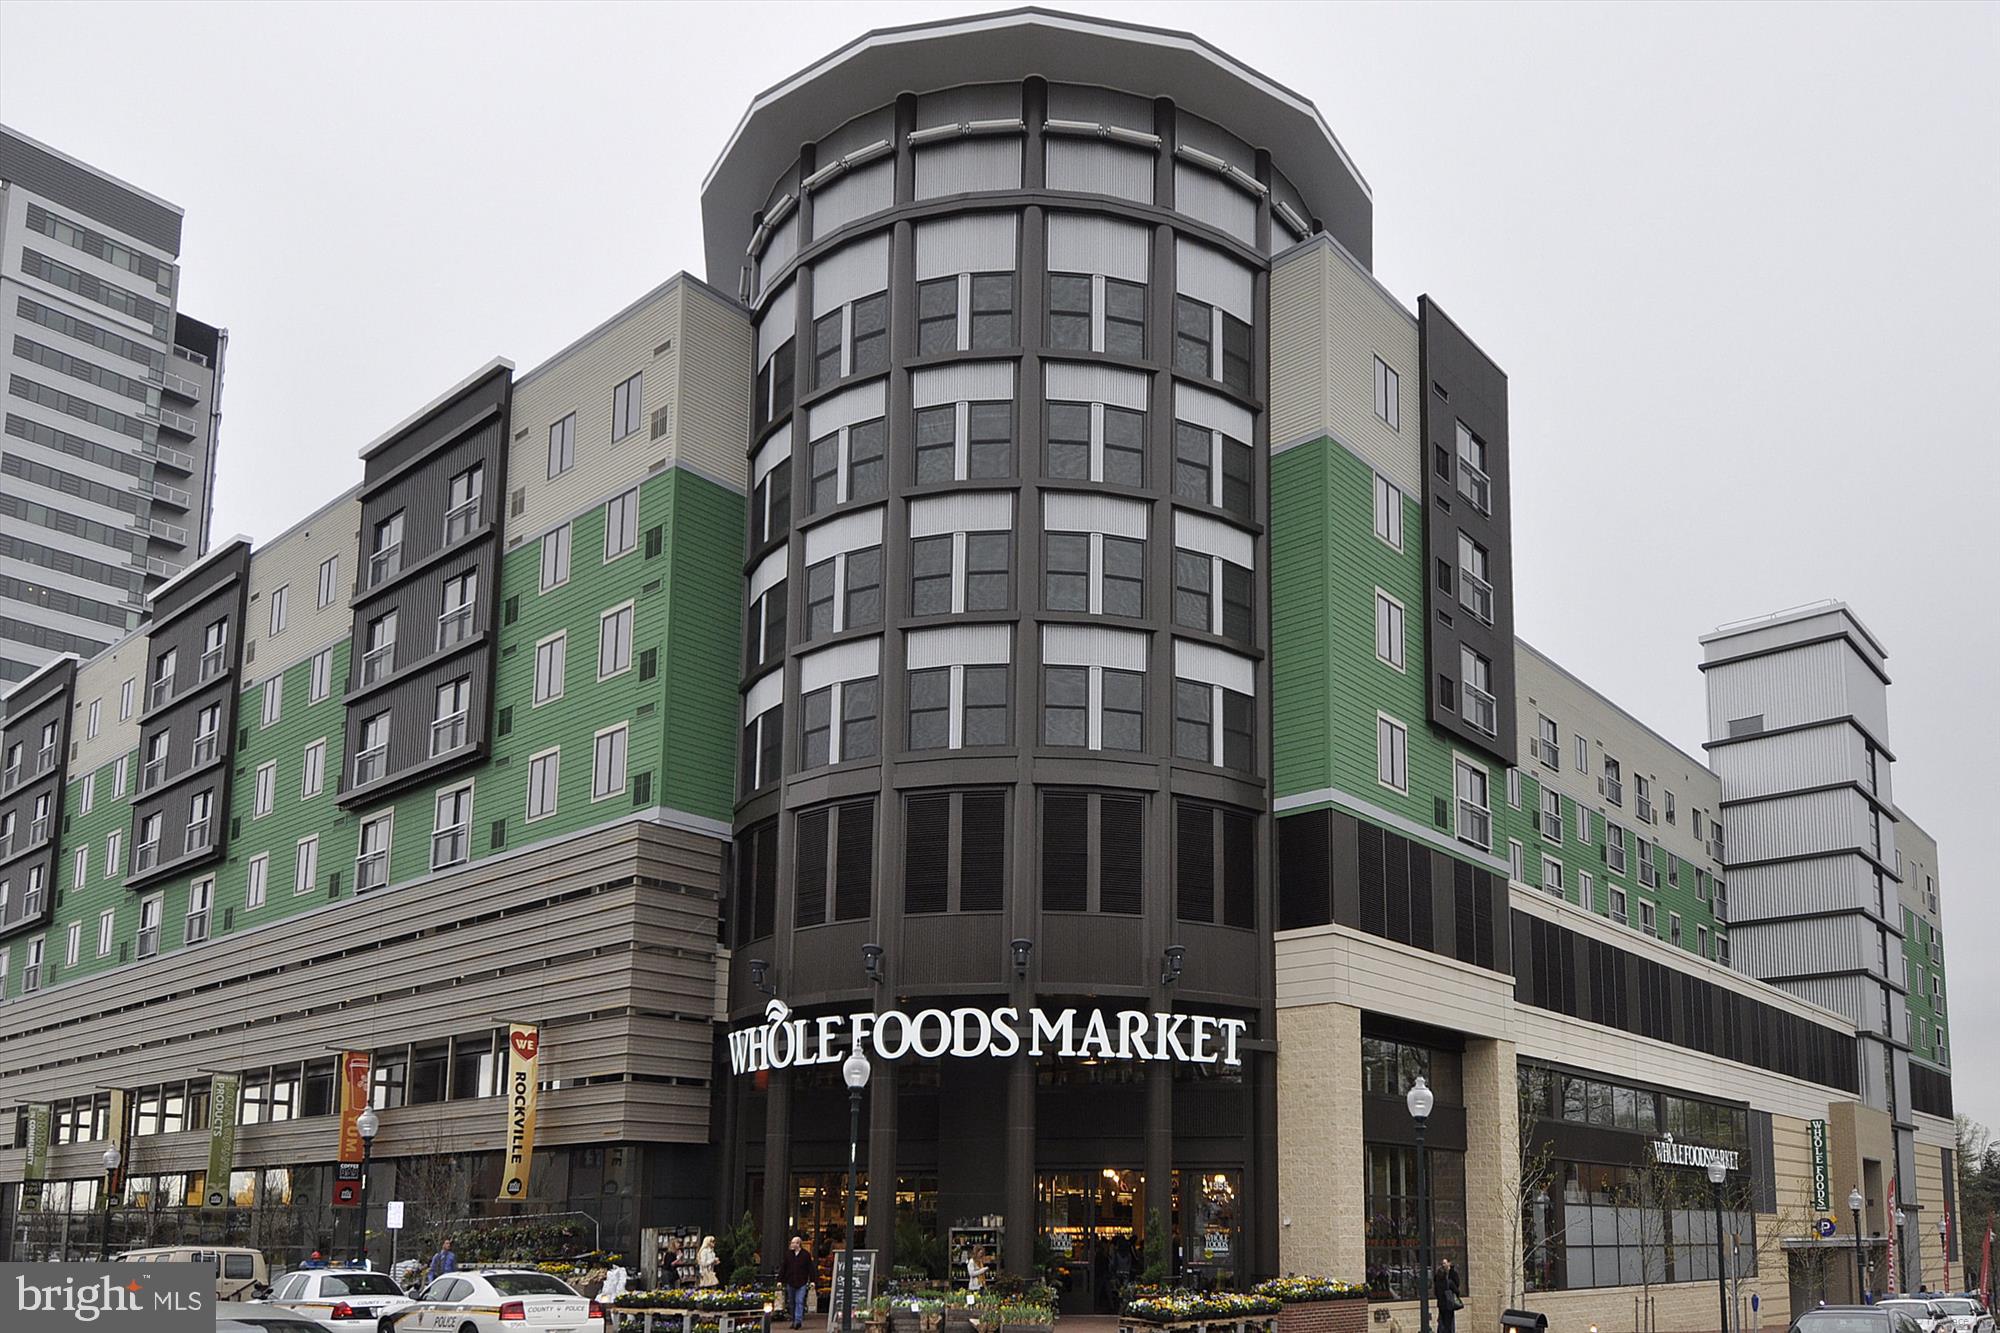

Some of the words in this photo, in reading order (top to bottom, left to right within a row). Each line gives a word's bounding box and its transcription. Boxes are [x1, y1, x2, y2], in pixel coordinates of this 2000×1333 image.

[515, 1038, 534, 1051] WE
[728, 999, 843, 1076] WHOLE
[849, 1008, 1020, 1060] FOODS
[1028, 1008, 1247, 1066] MARKET
[213, 1082, 225, 1137] PRODUCTS
[511, 1071, 527, 1164] ROCKVILLE
[27, 1119, 36, 1166] COMMUNITY
[1654, 1132, 1685, 1165] WHOLE
[1684, 1145, 1711, 1168] FOODS
[1812, 1120, 1824, 1164] WHOLE
[1816, 1166, 1826, 1207] FOODS
[1821, 1221, 1830, 1233] P
[434, 1316, 457, 1328] POLICE
[528, 1305, 553, 1313] COUNTY
